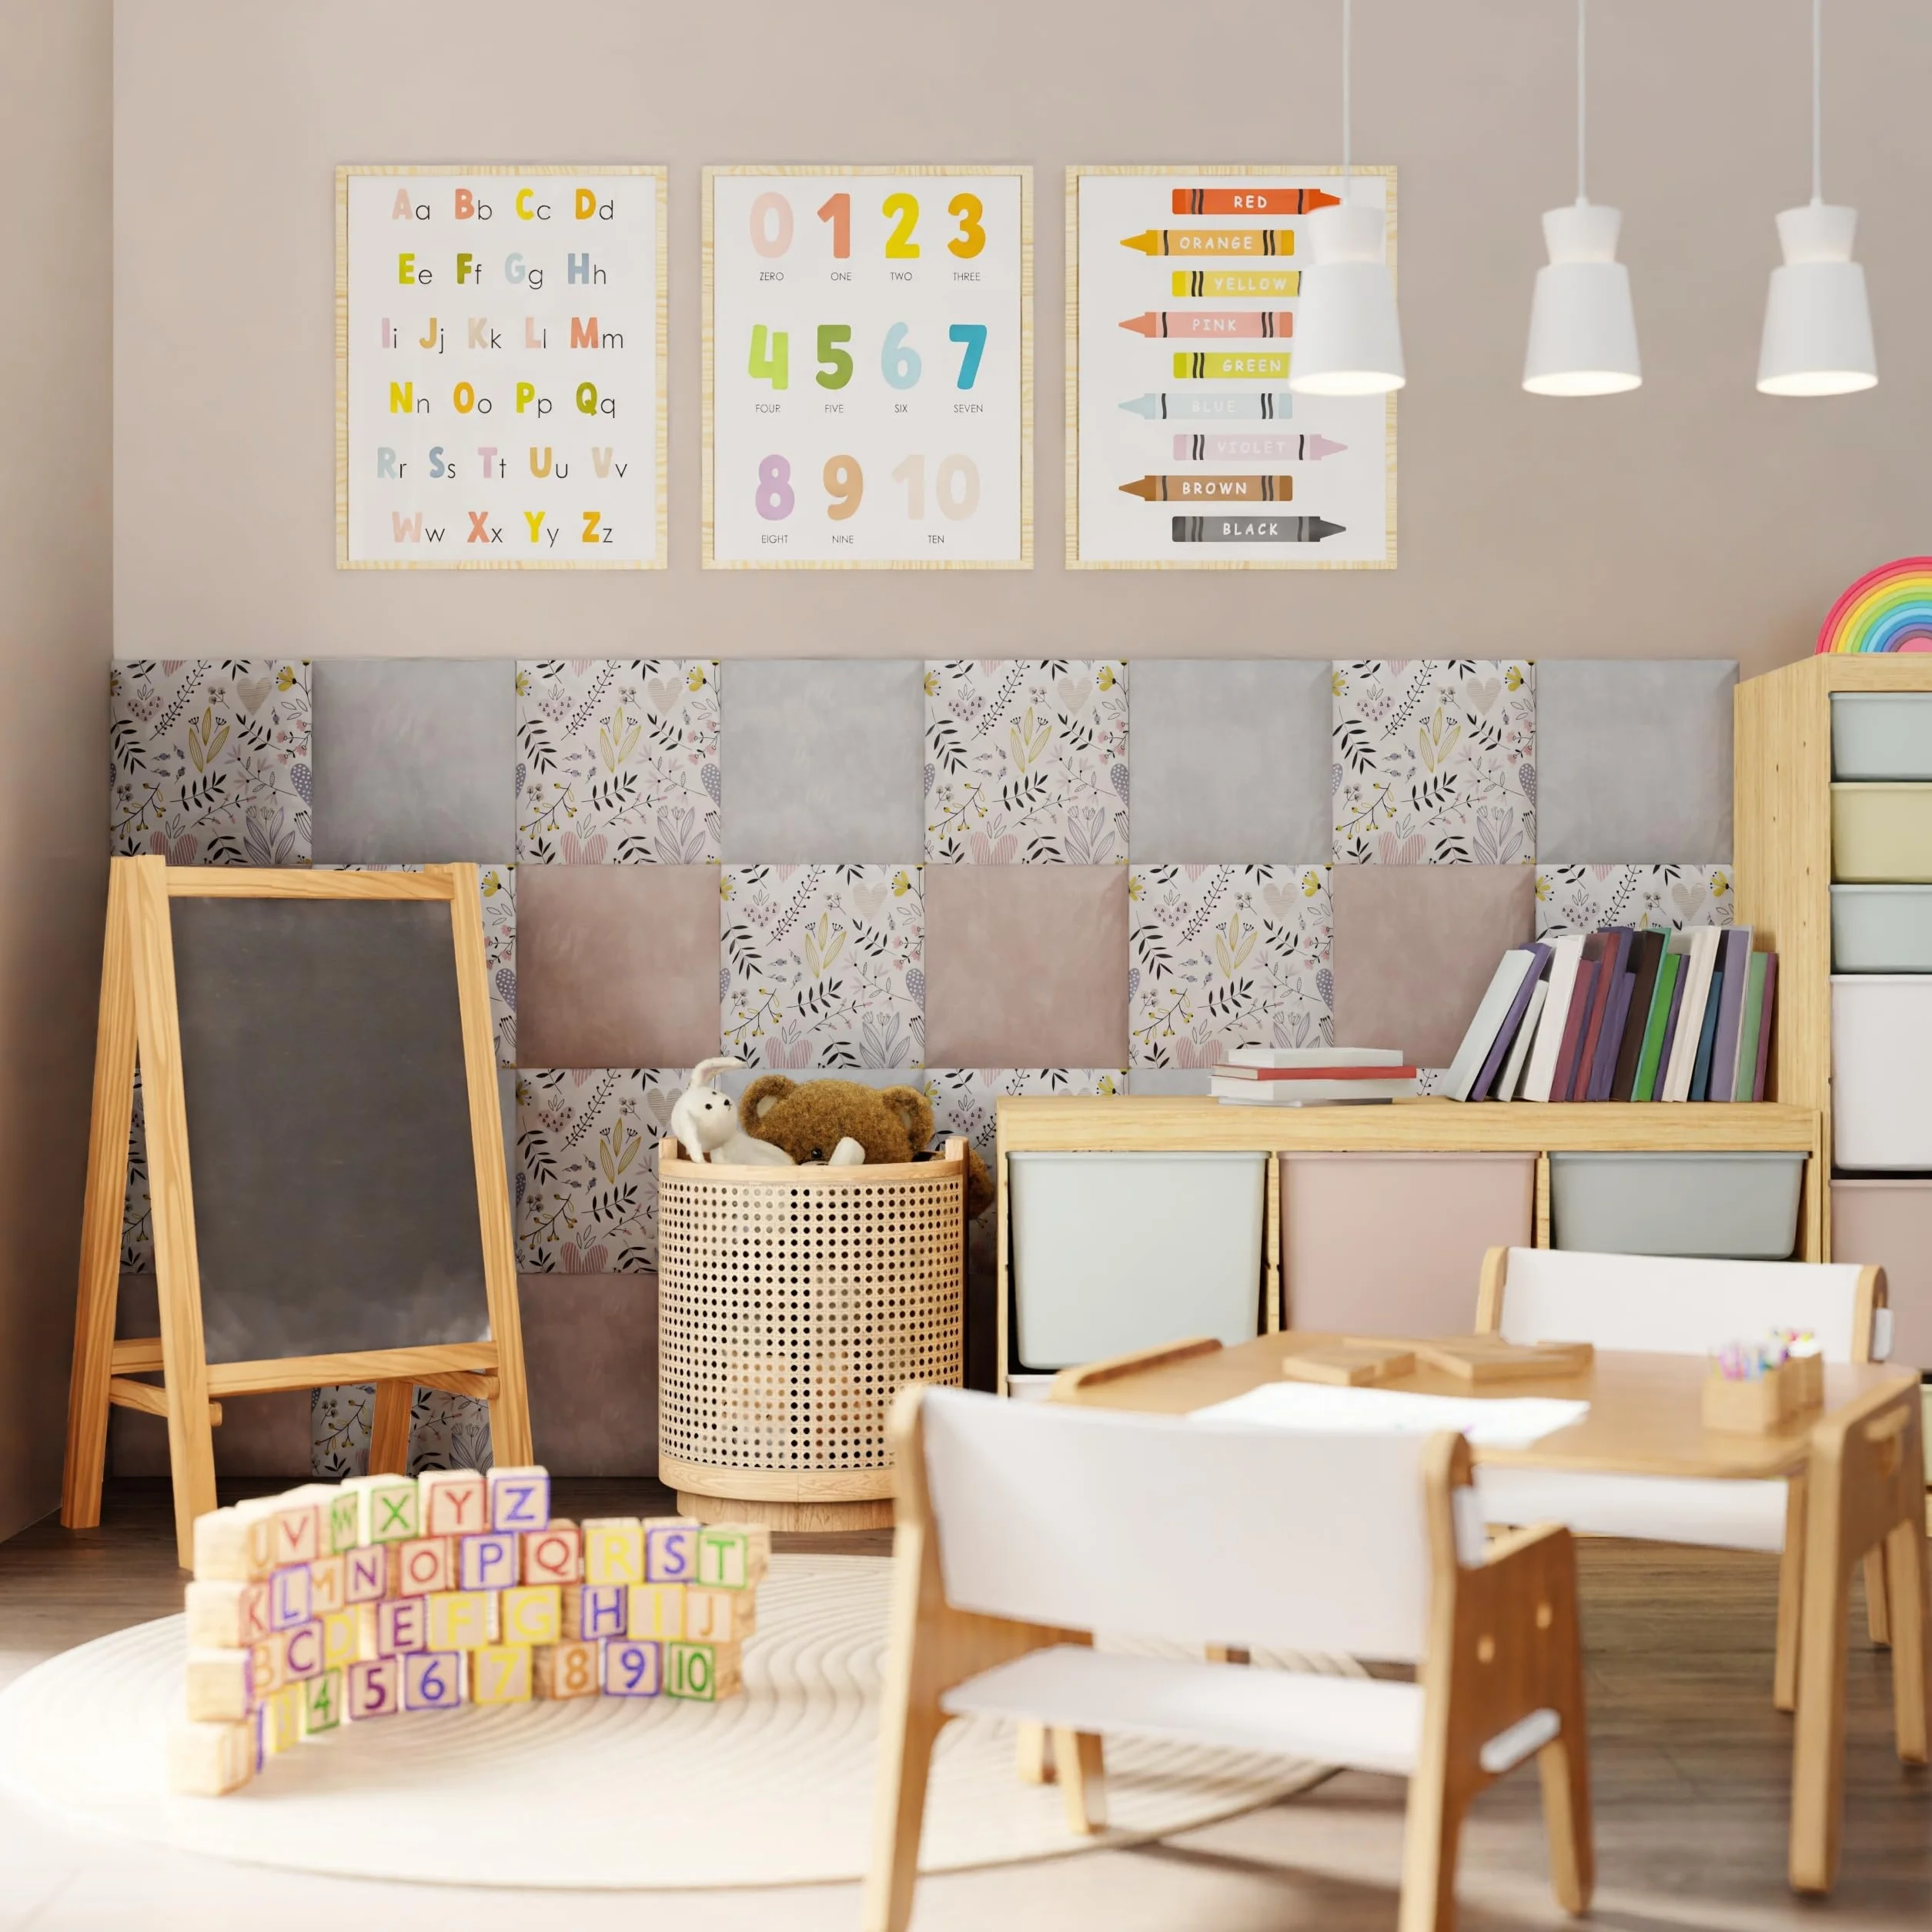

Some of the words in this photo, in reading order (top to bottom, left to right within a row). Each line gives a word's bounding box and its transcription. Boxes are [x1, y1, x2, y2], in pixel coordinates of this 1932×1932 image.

[392, 189, 431, 220] Aa
[454, 189, 493, 220] Bb
[516, 189, 552, 220] Cc
[575, 189, 614, 220] Dd
[1234, 196, 1267, 208] RED
[749, 192, 794, 259] 0
[817, 192, 851, 259] 1
[881, 192, 921, 259] 2
[947, 192, 986, 259] 3
[1179, 236, 1253, 249] ORANGE
[399, 252, 433, 285] Ee
[456, 252, 482, 285] Ff
[505, 252, 543, 290] Gg
[567, 252, 607, 285] Hh
[760, 272, 784, 282] ZERO
[831, 272, 852, 282] ONE
[891, 272, 913, 282] TWO
[953, 272, 981, 282] THREE
[1215, 278, 1287, 291] YELLOW
[382, 317, 397, 349] Ii
[419, 317, 445, 354] Jj
[468, 317, 502, 349] Kk
[570, 316, 624, 349] Mm
[1193, 319, 1236, 331] PINK
[747, 323, 789, 390] 4
[815, 324, 854, 390] 5
[881, 322, 922, 390] 6
[949, 324, 988, 390] 7
[1223, 359, 1281, 372] GREEN
[389, 381, 430, 413] Nn
[453, 381, 493, 413] Oo
[516, 382, 553, 418] Pp
[576, 382, 616, 419] Qq
[755, 403, 780, 413] FOUR
[824, 403, 844, 413] FIVE
[894, 403, 908, 413] SIX
[954, 403, 984, 413] SEVEN
[1192, 400, 1235, 413] BLUE
[377, 446, 407, 479] Rr
[429, 446, 456, 479] Ss
[478, 446, 506, 479] Tt
[530, 446, 569, 479] Uu
[592, 446, 627, 479] Vv
[1217, 442, 1285, 453] VIOLET
[755, 454, 795, 521] 8
[822, 454, 864, 521] 9
[891, 453, 981, 521] 10
[1182, 482, 1247, 495] BROWN
[392, 511, 446, 543] Ww
[467, 511, 503, 543] Xx
[523, 511, 559, 547] Yy
[582, 511, 613, 543] Zz
[761, 534, 788, 545] EIGHT
[832, 534, 854, 545] NINE
[928, 534, 944, 545] TEN
[1223, 523, 1278, 536] BLACK
[282, 1516, 309, 1549] V
[381, 1494, 409, 1533] X
[445, 1490, 473, 1524] Y
[505, 1487, 535, 1521] Z
[282, 1579, 299, 1619] L
[355, 1556, 376, 1590] N
[410, 1551, 438, 1583] O
[480, 1543, 502, 1582] P
[536, 1539, 569, 1576] Q
[604, 1537, 634, 1576] R
[663, 1535, 686, 1575] S
[707, 1539, 735, 1579] T
[288, 1630, 313, 1672] C
[393, 1606, 413, 1646] E
[447, 1602, 471, 1643] F
[513, 1596, 550, 1636] G
[593, 1588, 620, 1632] H
[655, 1593, 661, 1633] I
[700, 1596, 714, 1636] J
[314, 1680, 331, 1720] 4
[364, 1668, 386, 1710] 5
[420, 1660, 444, 1700] 6
[489, 1654, 520, 1697] 7
[565, 1649, 589, 1690] 8
[620, 1648, 645, 1689] 9
[677, 1650, 708, 1692] 10
